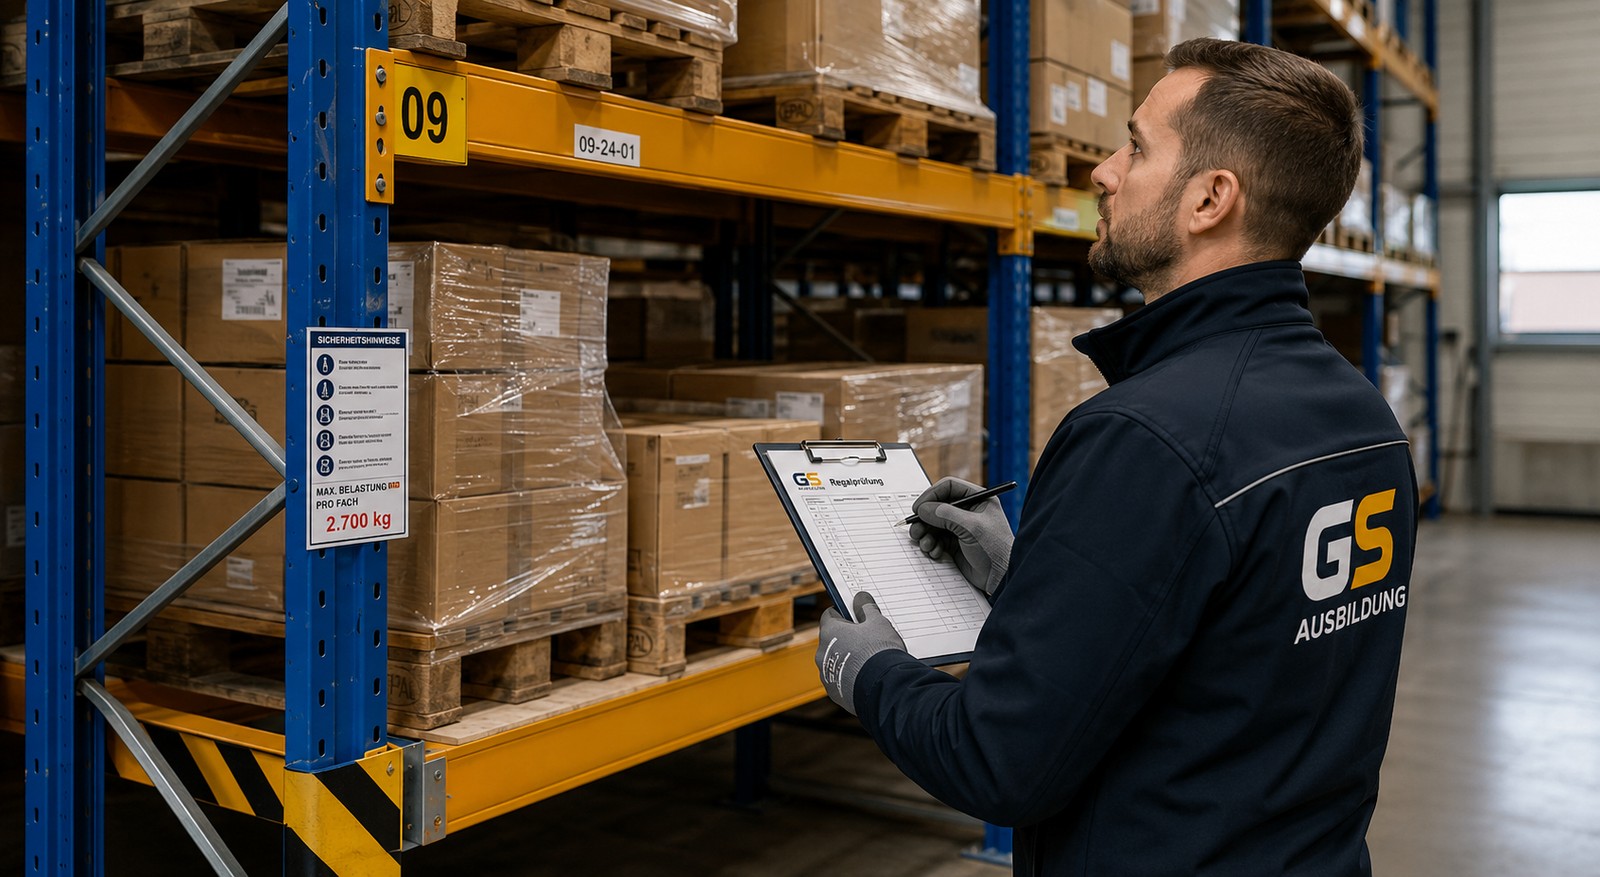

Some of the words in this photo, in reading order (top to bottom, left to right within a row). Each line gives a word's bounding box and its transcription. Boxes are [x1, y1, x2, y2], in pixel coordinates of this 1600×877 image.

[401, 86, 448, 144] 09
[579, 135, 635, 161] 09-24-01
[317, 335, 401, 345] SICHERHEITSHINWEISE
[792, 472, 822, 486] GS
[829, 477, 884, 488] Regalprüfung
[316, 487, 337, 497] MAX.
[339, 482, 387, 495] BELASTUNG
[316, 499, 334, 510] PRO
[336, 497, 359, 508] FACH
[326, 512, 368, 533] 2.700
[373, 511, 391, 530] kg
[1301, 488, 1396, 602] GS
[1293, 585, 1407, 645] AUSBILDUNG
